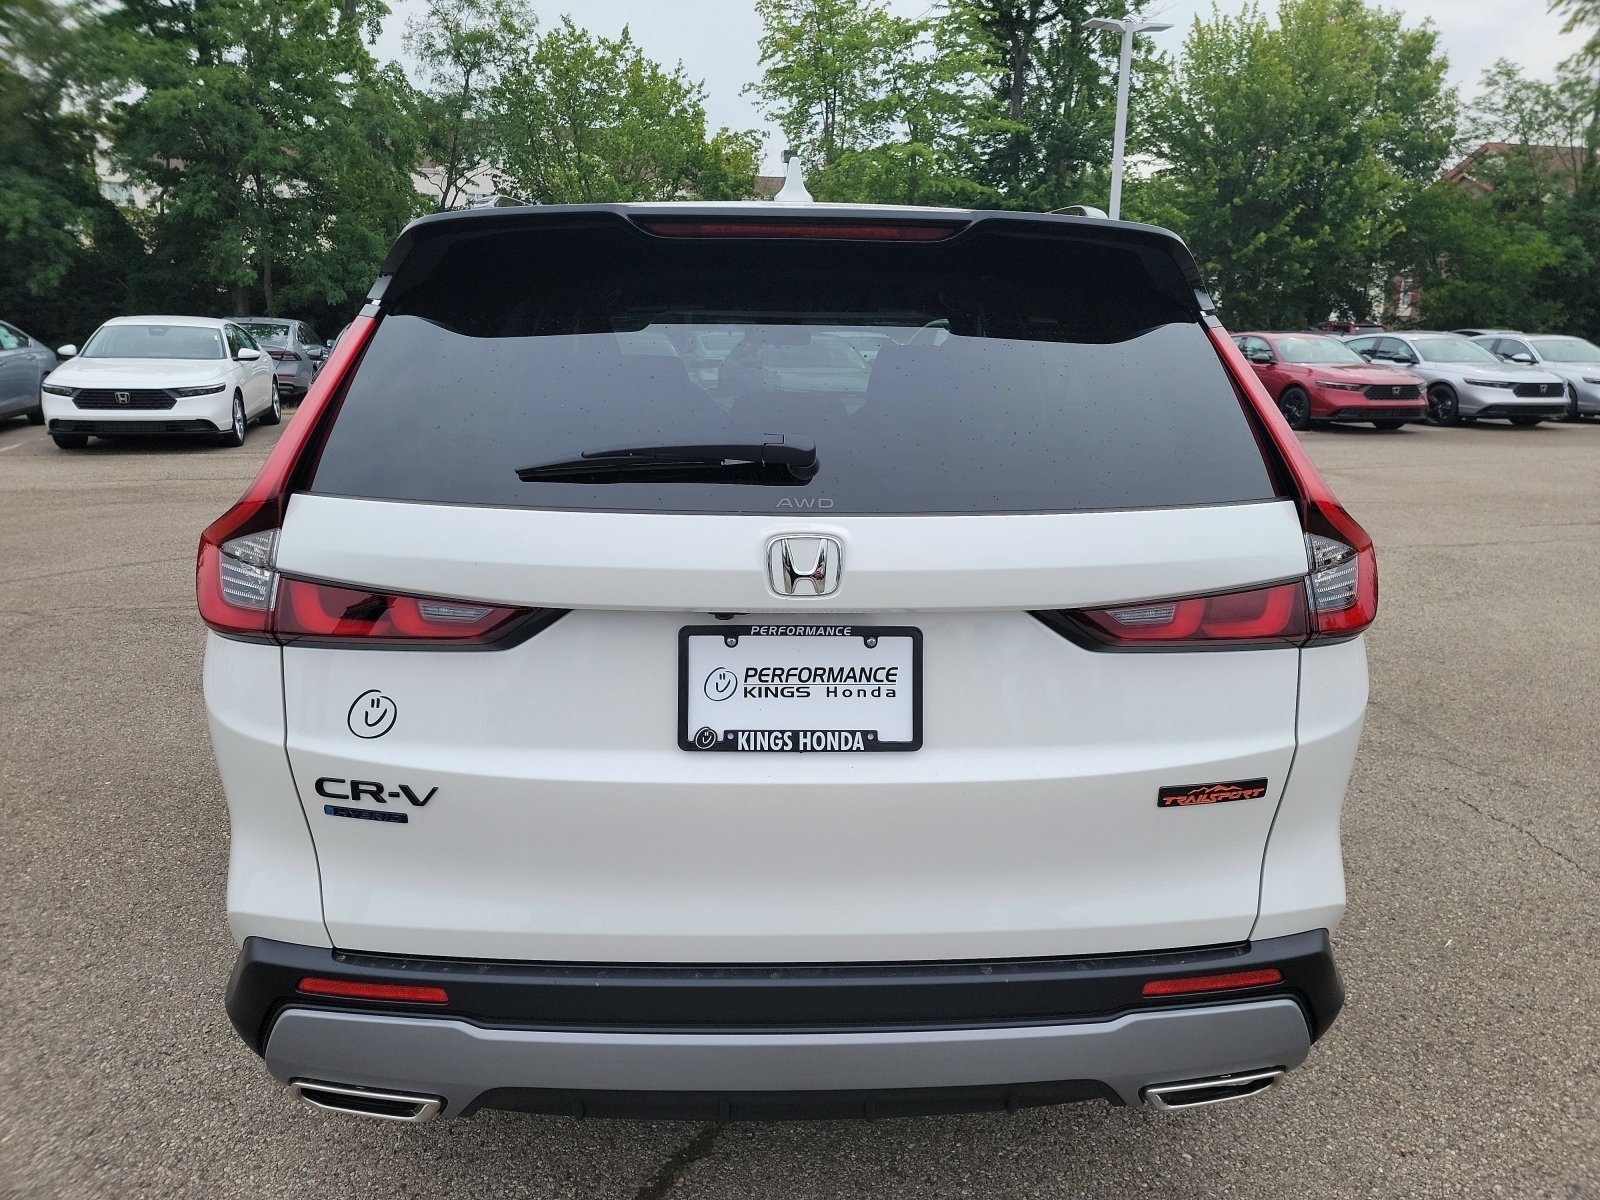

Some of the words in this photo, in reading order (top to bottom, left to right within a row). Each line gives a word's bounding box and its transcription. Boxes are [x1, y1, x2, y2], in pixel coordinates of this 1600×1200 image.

[775, 498, 834, 508] AWD
[750, 626, 852, 636] PERFORMANCE
[743, 666, 899, 684] PERFORMANCE
[743, 686, 811, 698] KINGS
[826, 686, 897, 698] Honda
[737, 731, 793, 751] KINGS
[799, 731, 865, 751] HONDA
[314, 777, 439, 807] CR-V
[1162, 787, 1265, 806] TRAILSPORT
